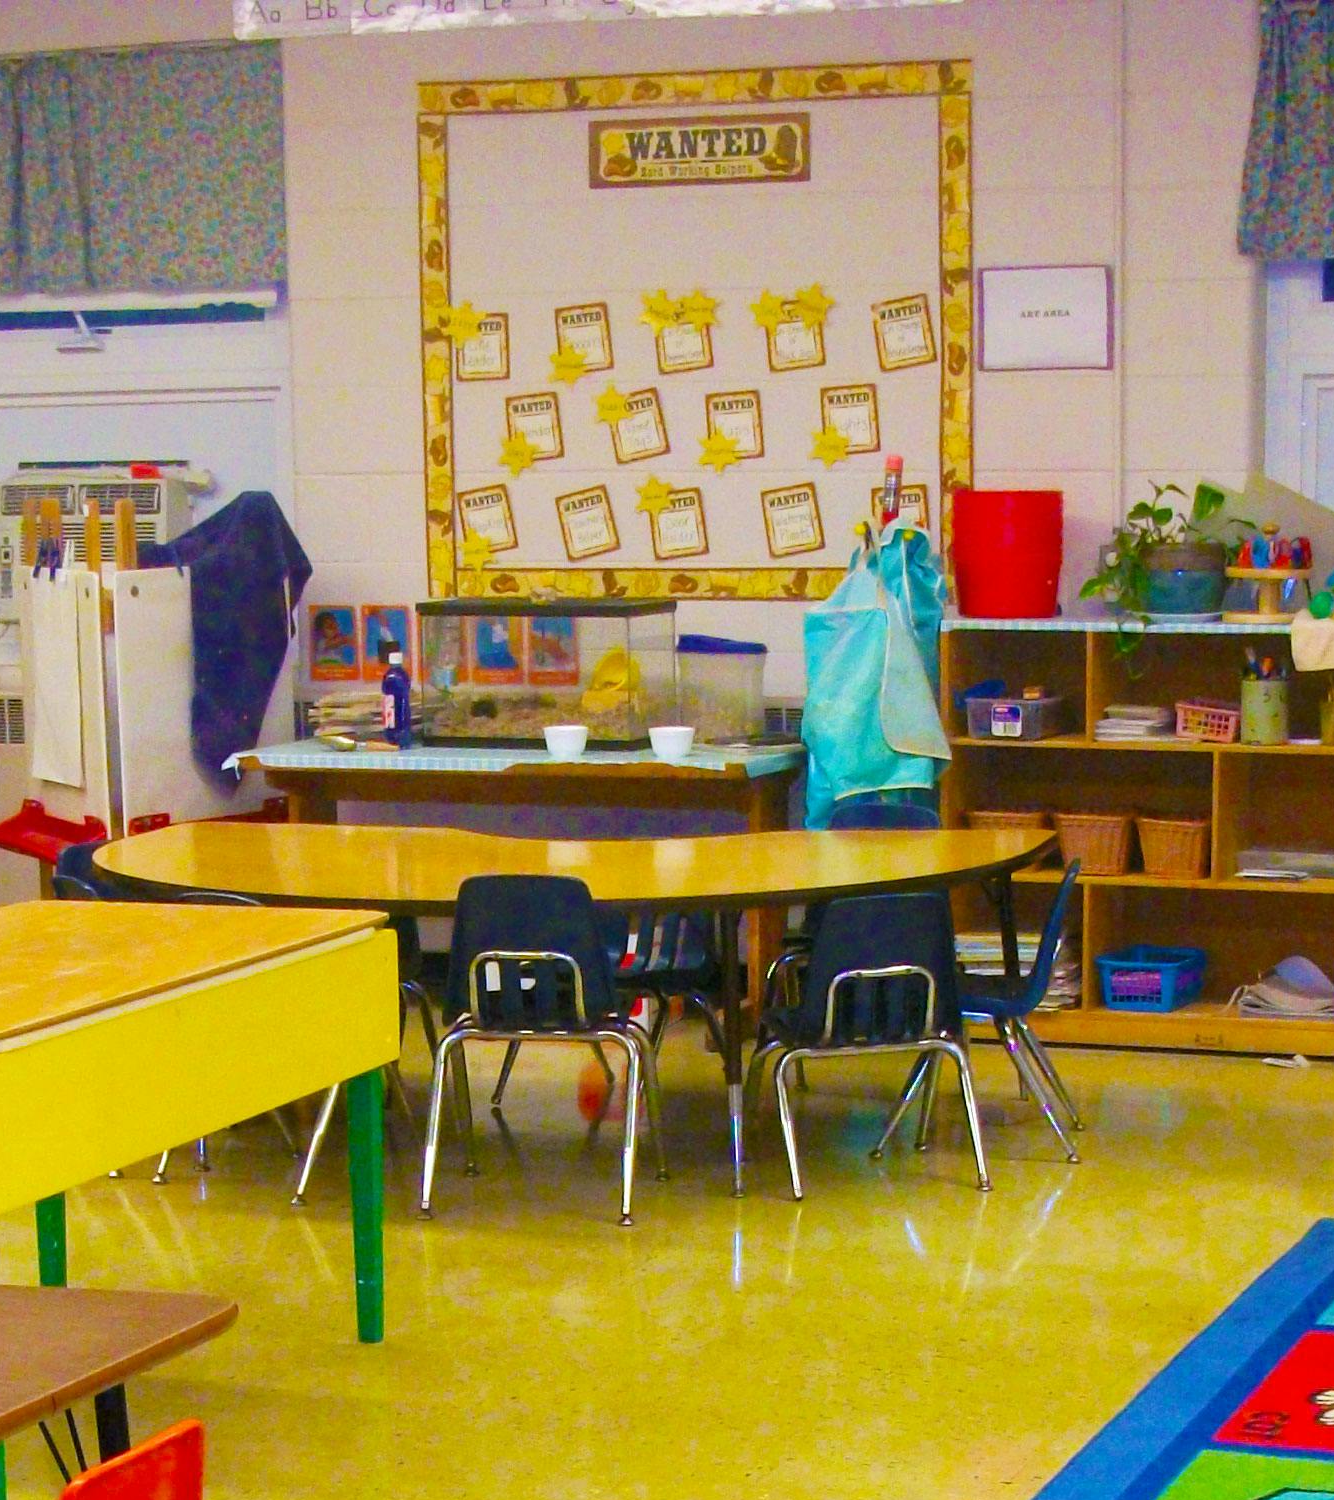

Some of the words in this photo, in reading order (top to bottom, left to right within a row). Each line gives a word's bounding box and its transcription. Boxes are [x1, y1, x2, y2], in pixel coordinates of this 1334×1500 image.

[626, 127, 767, 160] WANTED
[561, 311, 603, 325] WANTED
[879, 304, 922, 321] WANTED
[1019, 310, 1041, 318] ART
[1043, 309, 1071, 318] AREA
[479, 320, 502, 332] TED
[626, 398, 653, 412] NTED
[712, 399, 754, 411] WANTED
[827, 392, 870, 405] WANTED
[512, 400, 552, 414] WANTED
[464, 493, 503, 508] WANTED
[564, 494, 603, 512] WANTED
[671, 496, 696, 508] NTED
[769, 492, 810, 507] WANTED
